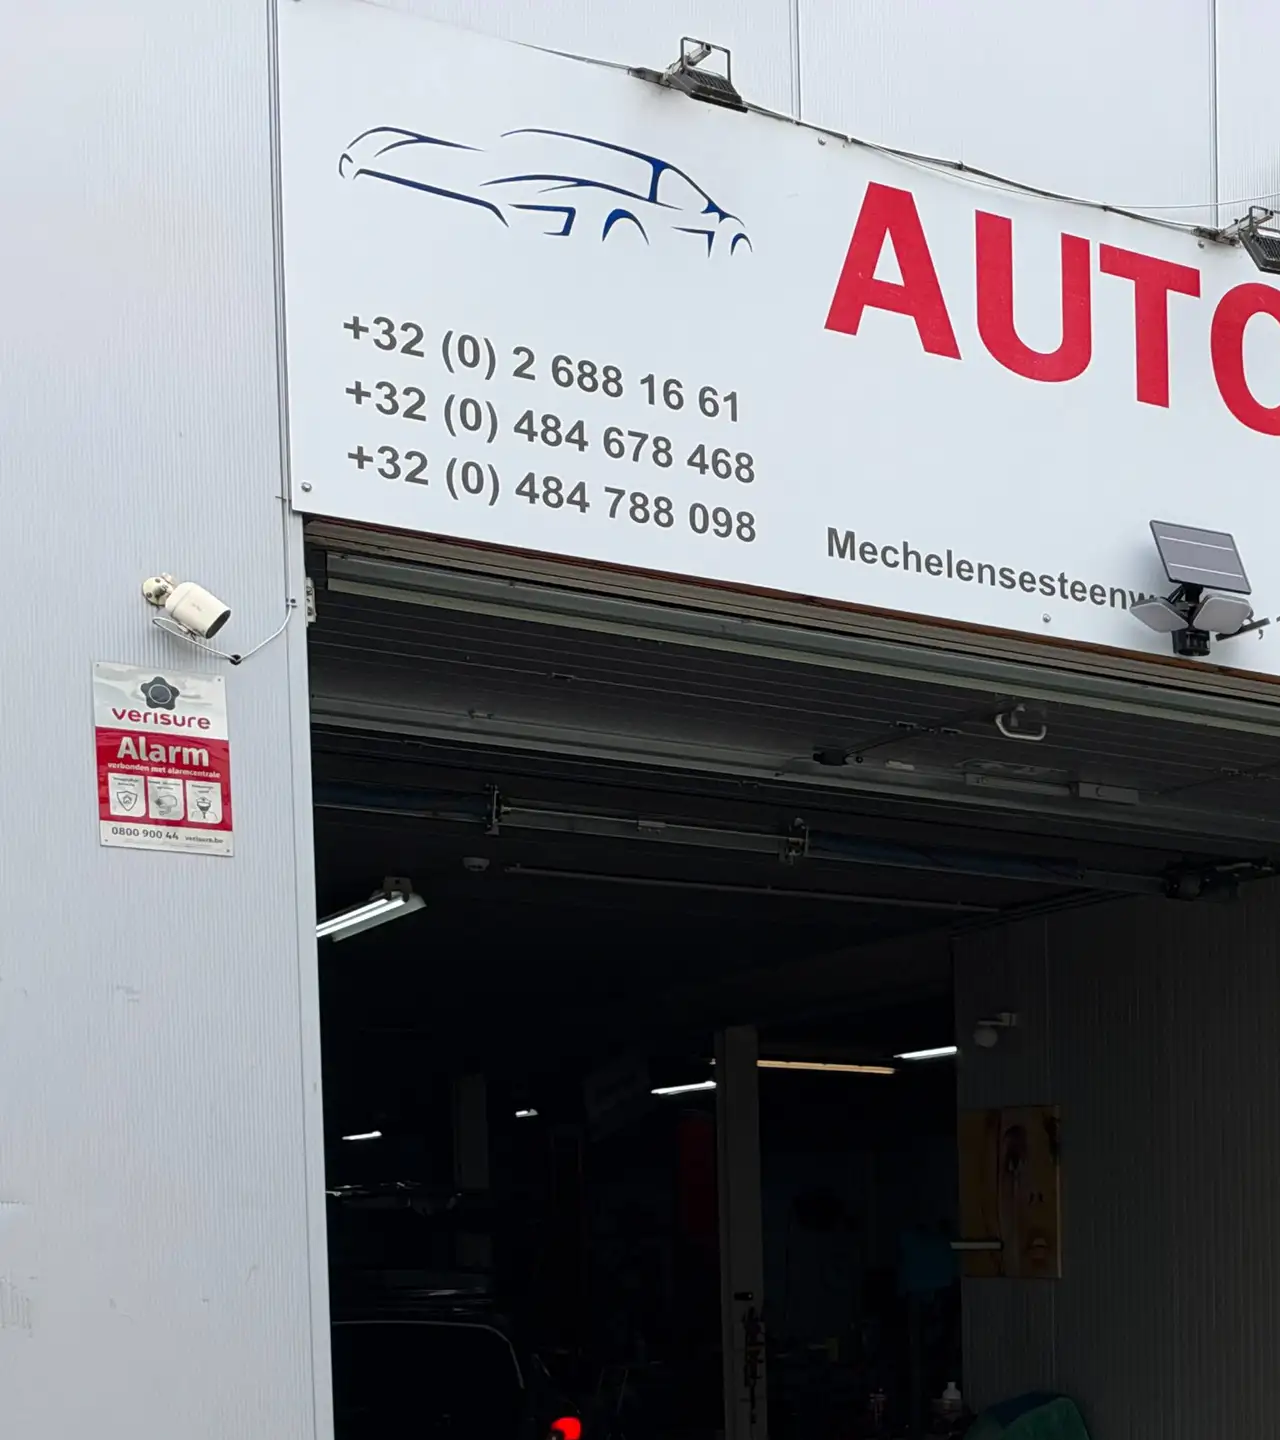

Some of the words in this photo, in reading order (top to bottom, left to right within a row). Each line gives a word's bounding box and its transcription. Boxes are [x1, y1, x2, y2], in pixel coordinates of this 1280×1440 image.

[343, 315, 425, 358] +32
[442, 330, 496, 381] (0)
[512, 346, 536, 381] 2
[551, 354, 624, 398] 688
[640, 373, 684, 411] 16
[698, 386, 738, 423] 61
[345, 380, 427, 422] +32
[444, 394, 498, 444] (0)
[513, 409, 589, 452] 484
[603, 426, 673, 468] 678
[686, 443, 755, 484] 468
[347, 445, 429, 486] +32
[446, 457, 500, 507] (0)
[515, 471, 591, 514] 484
[604, 486, 674, 528] 788
[689, 502, 756, 543] 098
[827, 526, 1156, 611] Mechelensesteen
[111, 707, 211, 730] verisure
[108, 762, 150, 773] verbonden
[151, 765, 166, 774] met
[167, 768, 221, 778] alarmcentrale
[117, 736, 209, 767] Alarm
[111, 826, 140, 837] 0800
[142, 829, 163, 839] 900
[165, 831, 179, 840] 44
